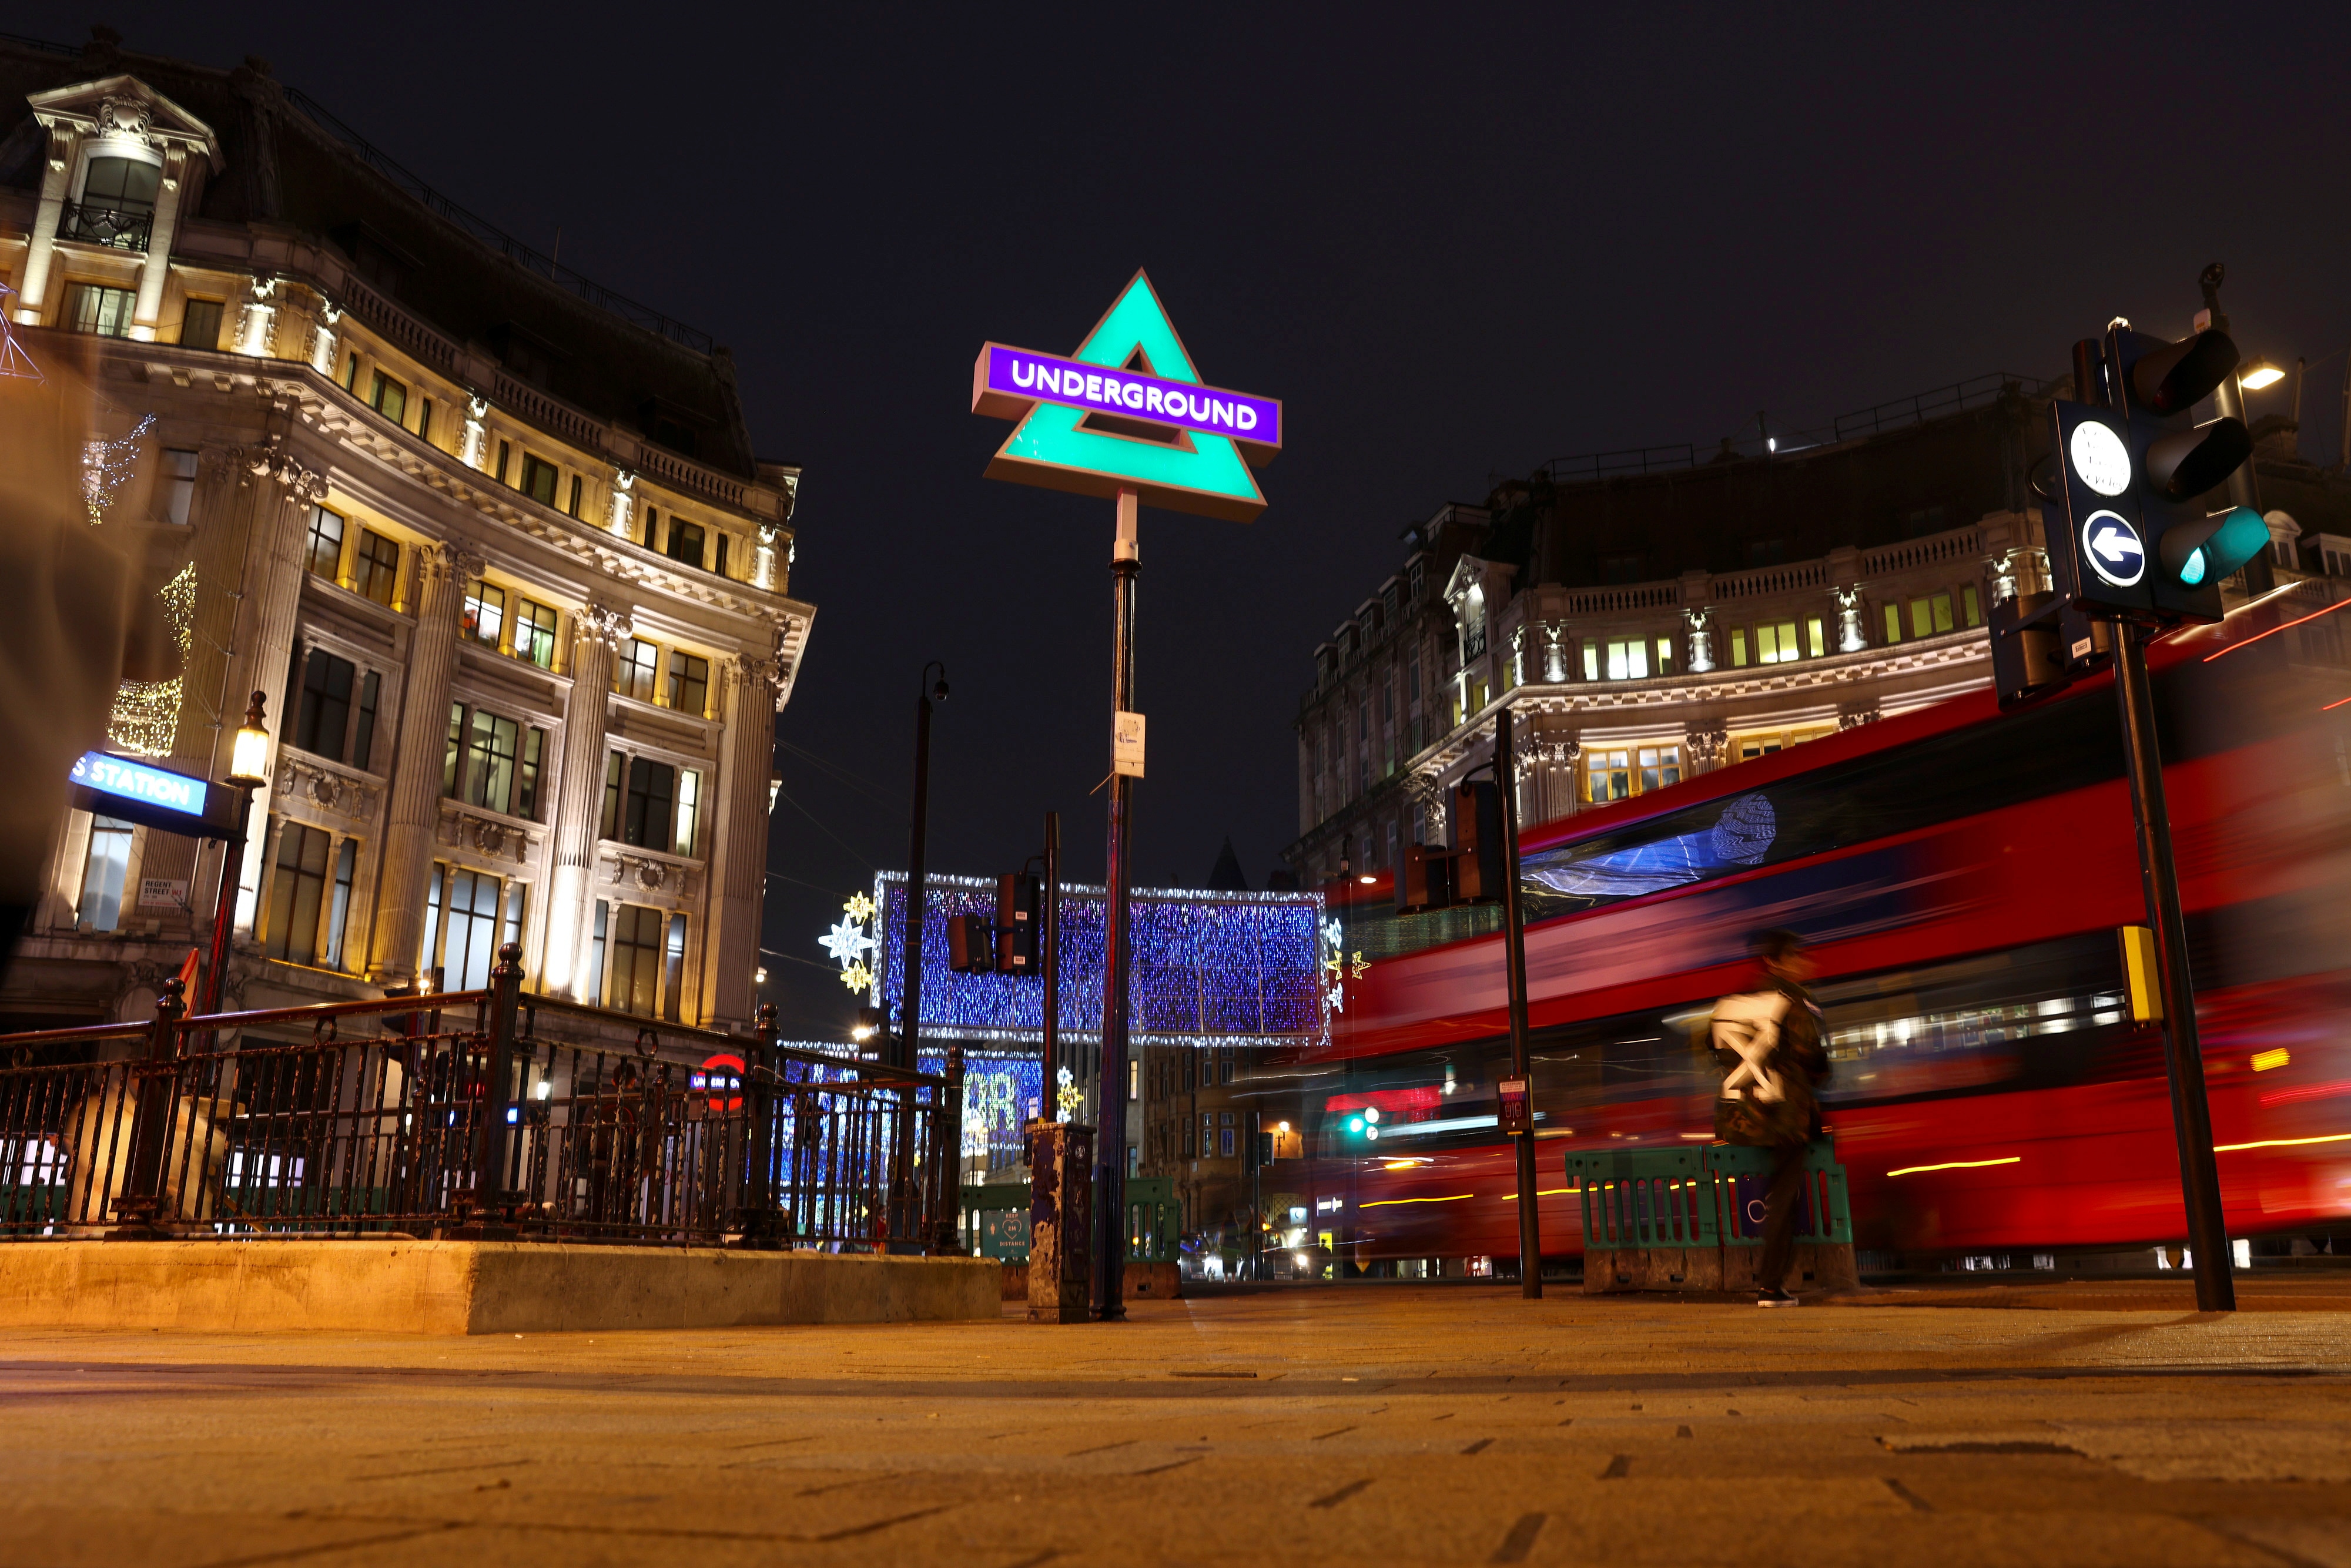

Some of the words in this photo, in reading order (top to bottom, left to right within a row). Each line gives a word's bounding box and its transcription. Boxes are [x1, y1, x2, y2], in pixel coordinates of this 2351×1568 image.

[1012, 360, 1257, 430] UNDERGROUND
[2086, 473, 2122, 491] cycles
[91, 761, 190, 805] STATION
[1502, 1093, 1523, 1101] WAIT
